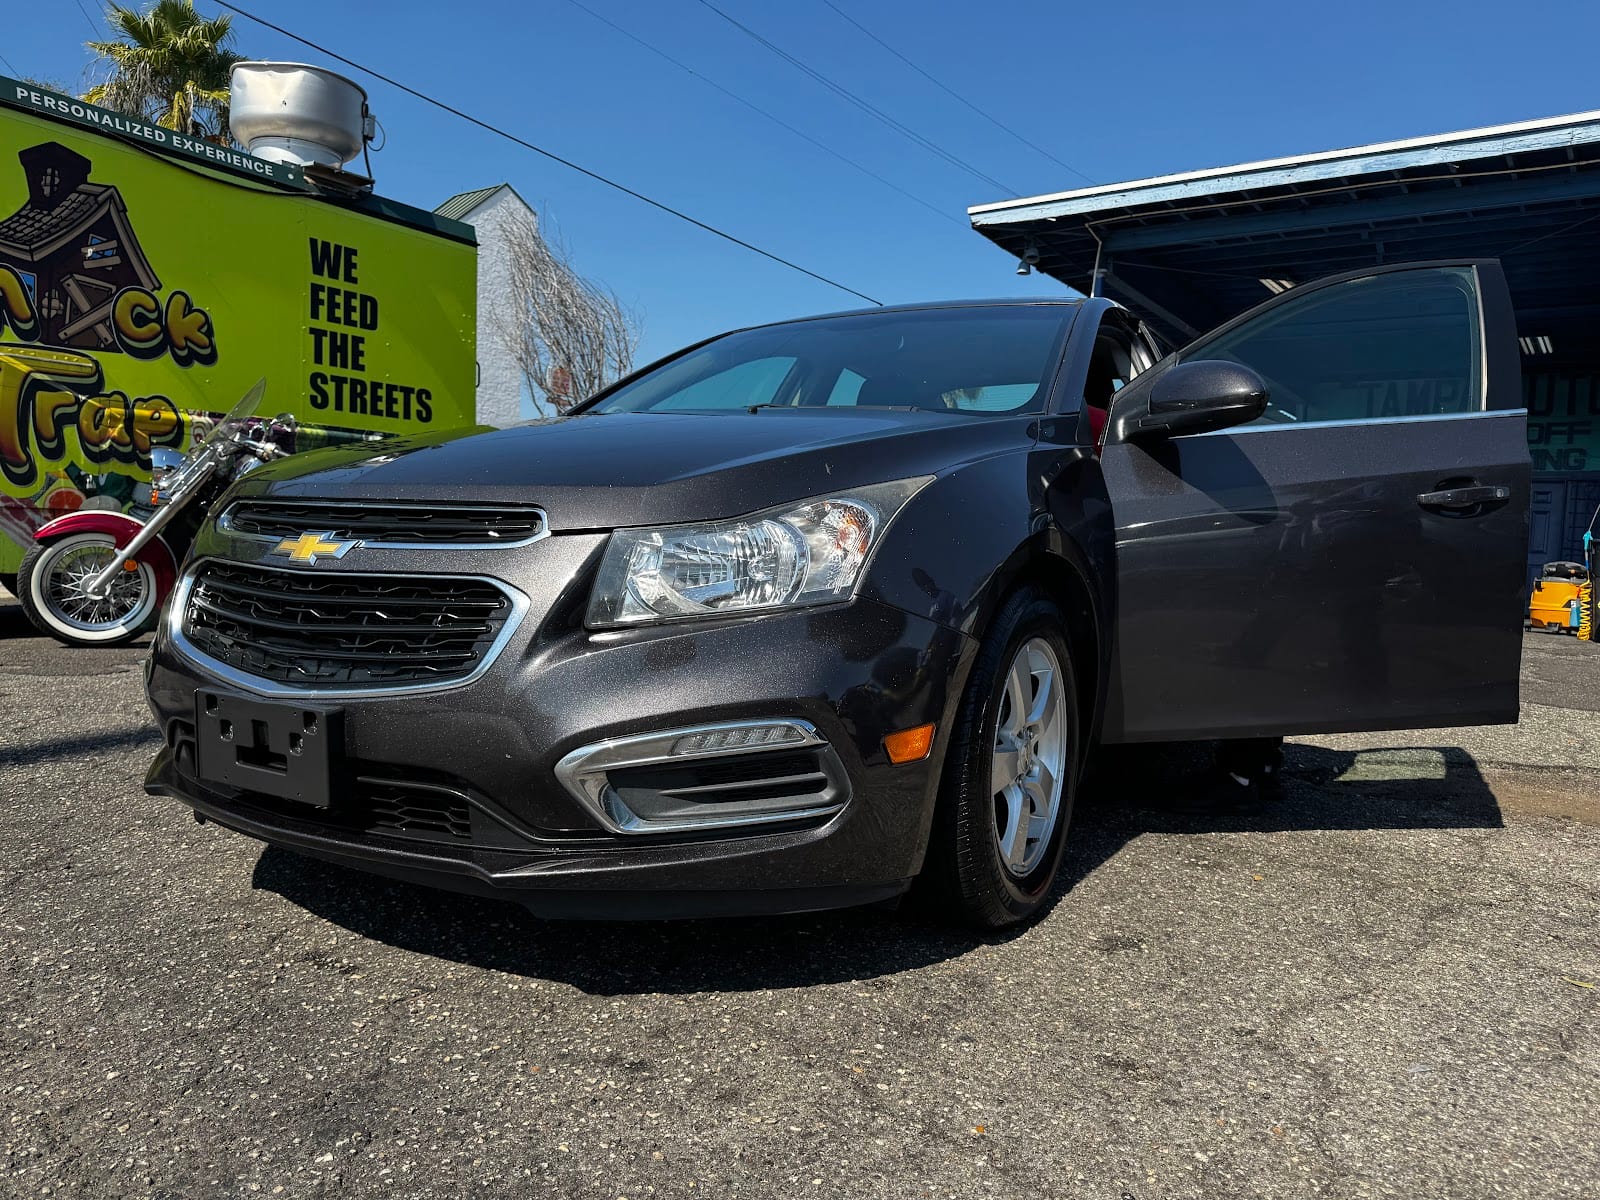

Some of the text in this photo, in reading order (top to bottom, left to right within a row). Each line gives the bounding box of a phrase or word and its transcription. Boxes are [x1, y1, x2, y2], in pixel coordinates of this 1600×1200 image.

[15, 86, 274, 177] PERSONALIZED EXPERIENCE
[309, 237, 358, 285] WE
[310, 282, 379, 331] FEED
[309, 327, 366, 372] THE
[309, 371, 433, 423] STREETS
